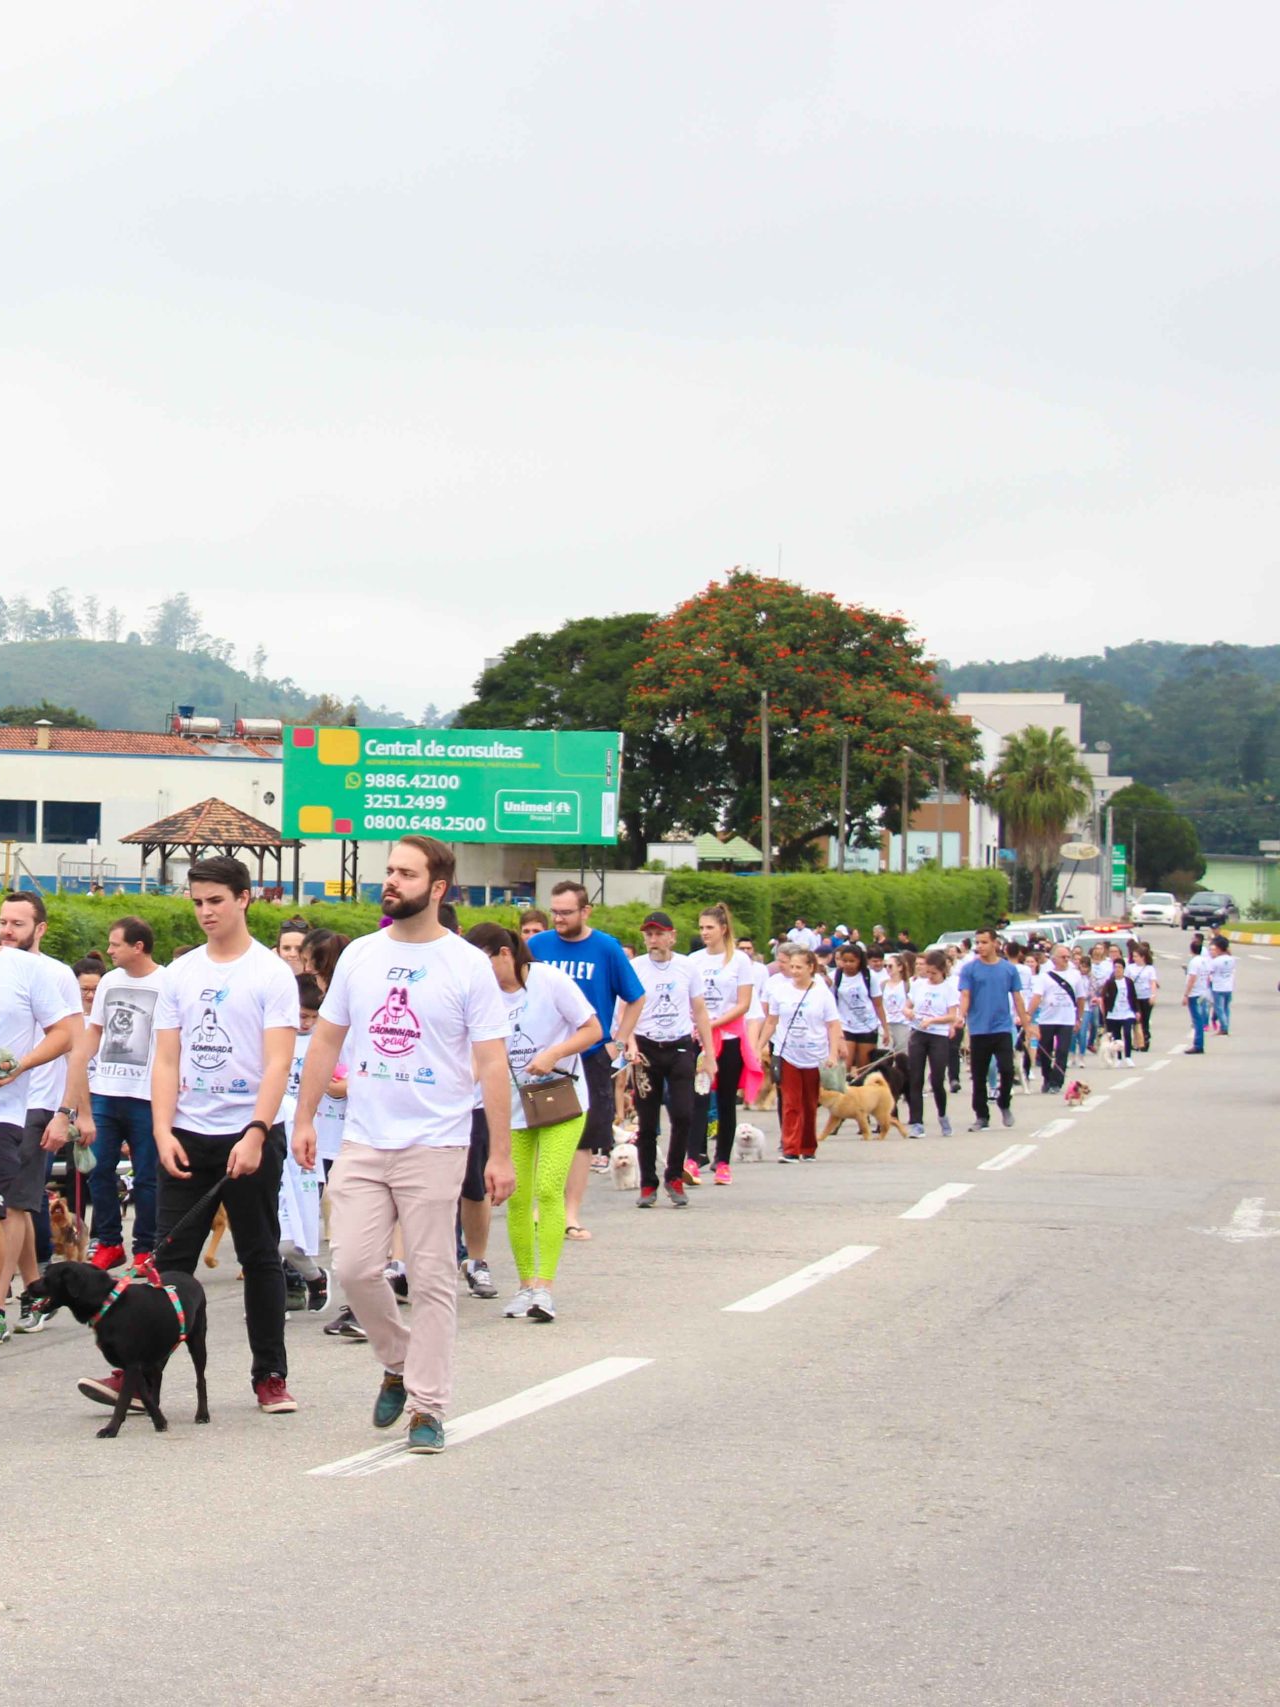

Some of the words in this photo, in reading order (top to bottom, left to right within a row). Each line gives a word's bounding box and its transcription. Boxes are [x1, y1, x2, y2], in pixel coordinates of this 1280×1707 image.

[364, 739, 423, 757] Central
[424, 740, 447, 757] de
[447, 741, 524, 759] consultas
[364, 773, 461, 790] 9886.42100
[363, 793, 447, 810] 3251.2499
[503, 801, 553, 813] Unimed
[363, 815, 487, 832] 0800.648.2500
[190, 1041, 233, 1054] ÃOMINHADA
